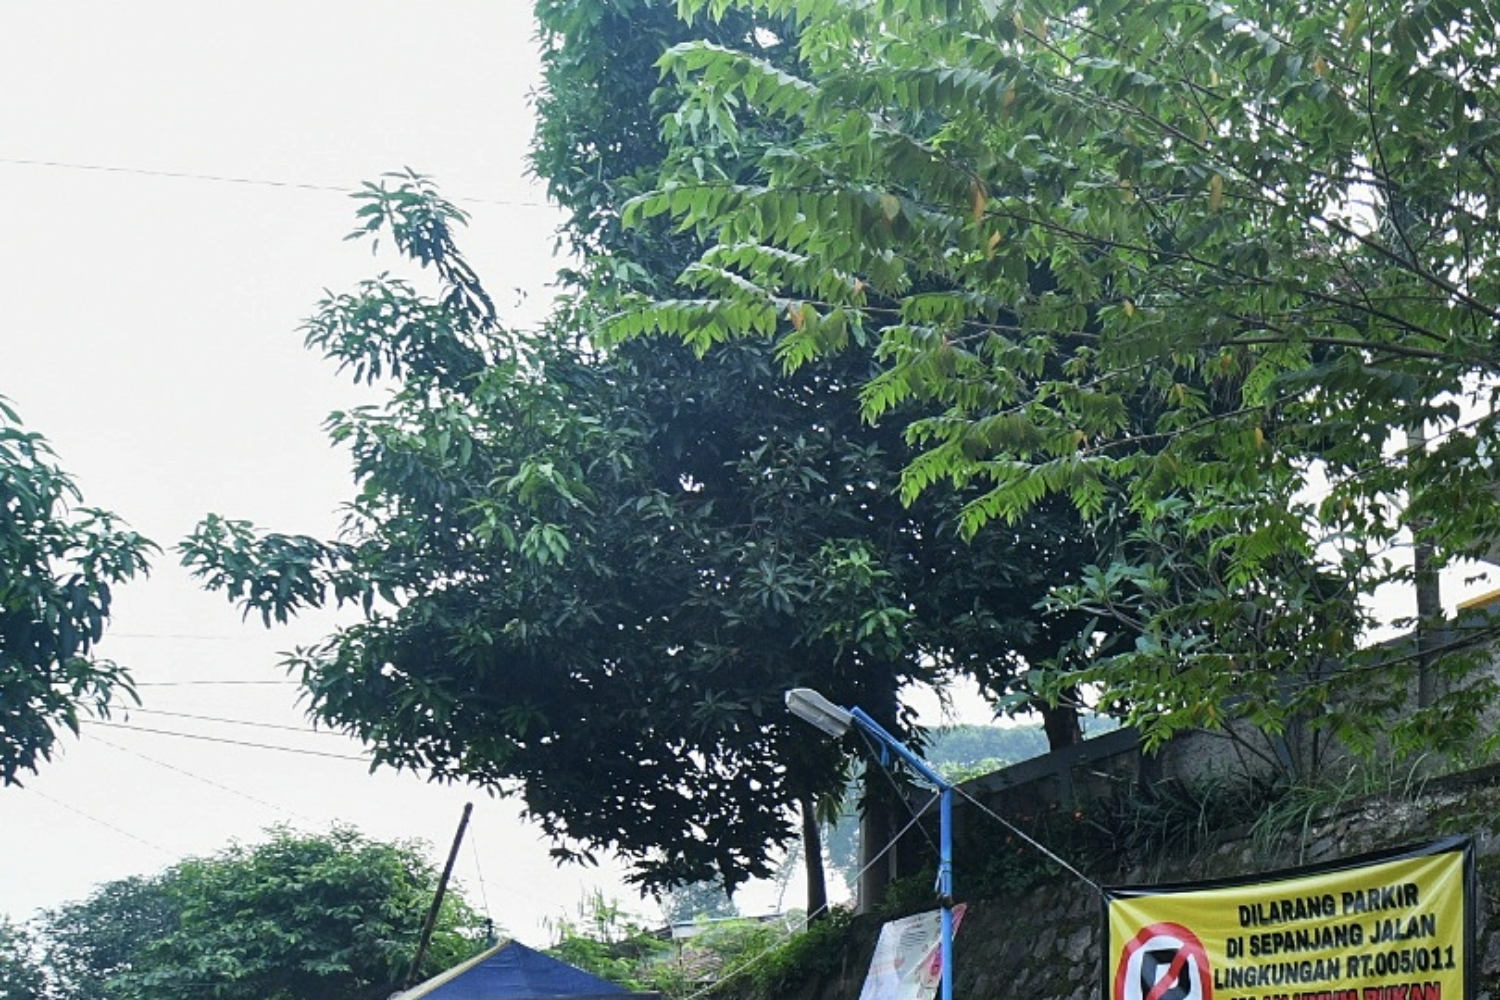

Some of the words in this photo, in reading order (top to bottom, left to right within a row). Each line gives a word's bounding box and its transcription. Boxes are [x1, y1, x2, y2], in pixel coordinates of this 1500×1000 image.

[1239, 895, 1335, 928] DILARANG
[1342, 883, 1419, 914] PARKIR
[1226, 937, 1244, 959] DI
[1250, 923, 1363, 958] SEPANJANG
[1370, 914, 1436, 942] JALAN
[1215, 956, 1340, 990] LINGKUNGAN
[1346, 946, 1455, 979] RT.005/011
